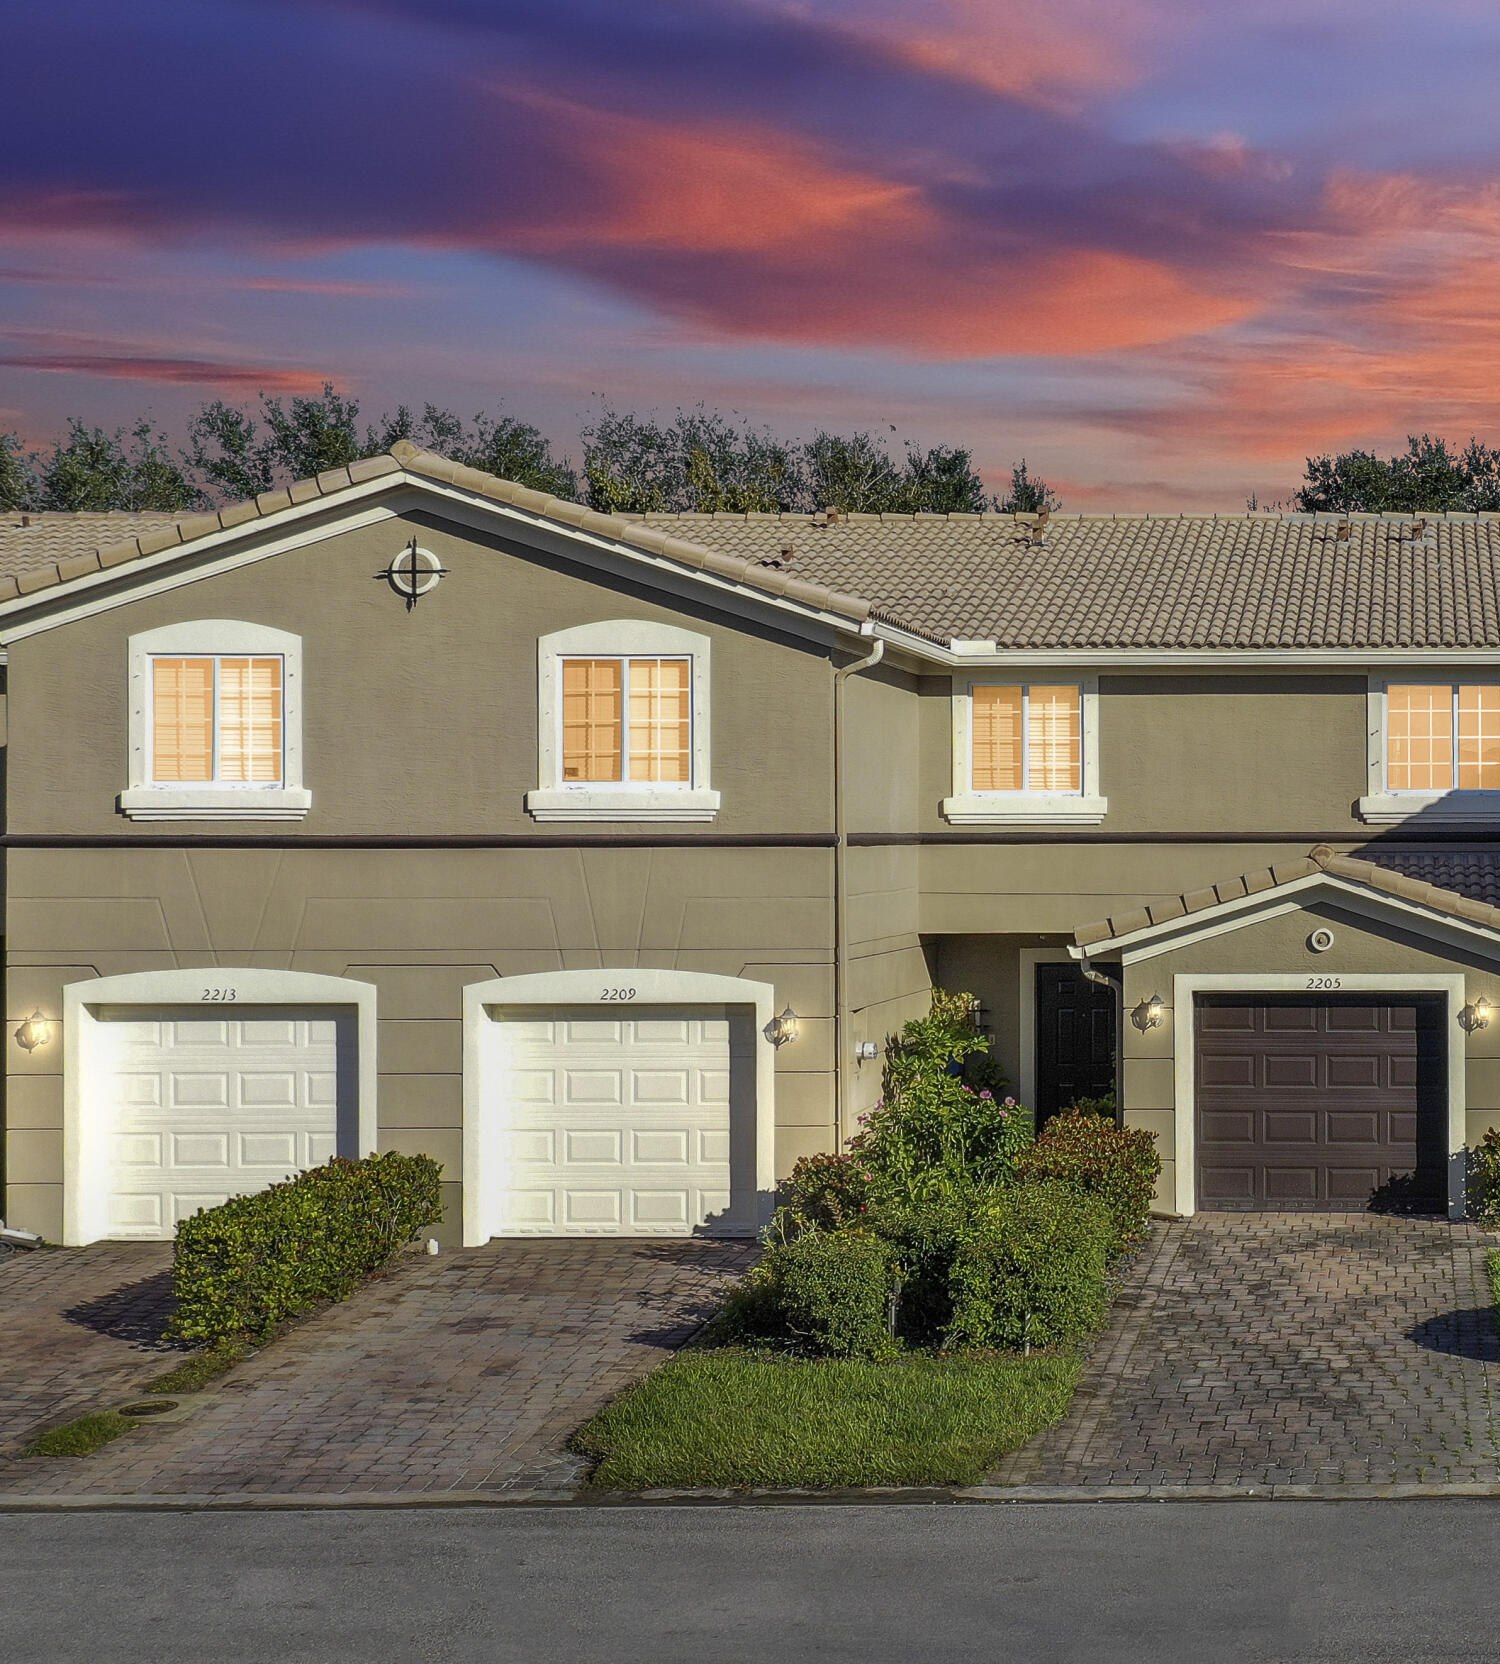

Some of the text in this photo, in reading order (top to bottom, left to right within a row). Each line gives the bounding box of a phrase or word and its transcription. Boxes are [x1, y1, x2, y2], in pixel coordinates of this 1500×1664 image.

[1306, 978, 1341, 989] 2205
[202, 989, 236, 1001] 2213
[600, 988, 636, 1000] 2209
